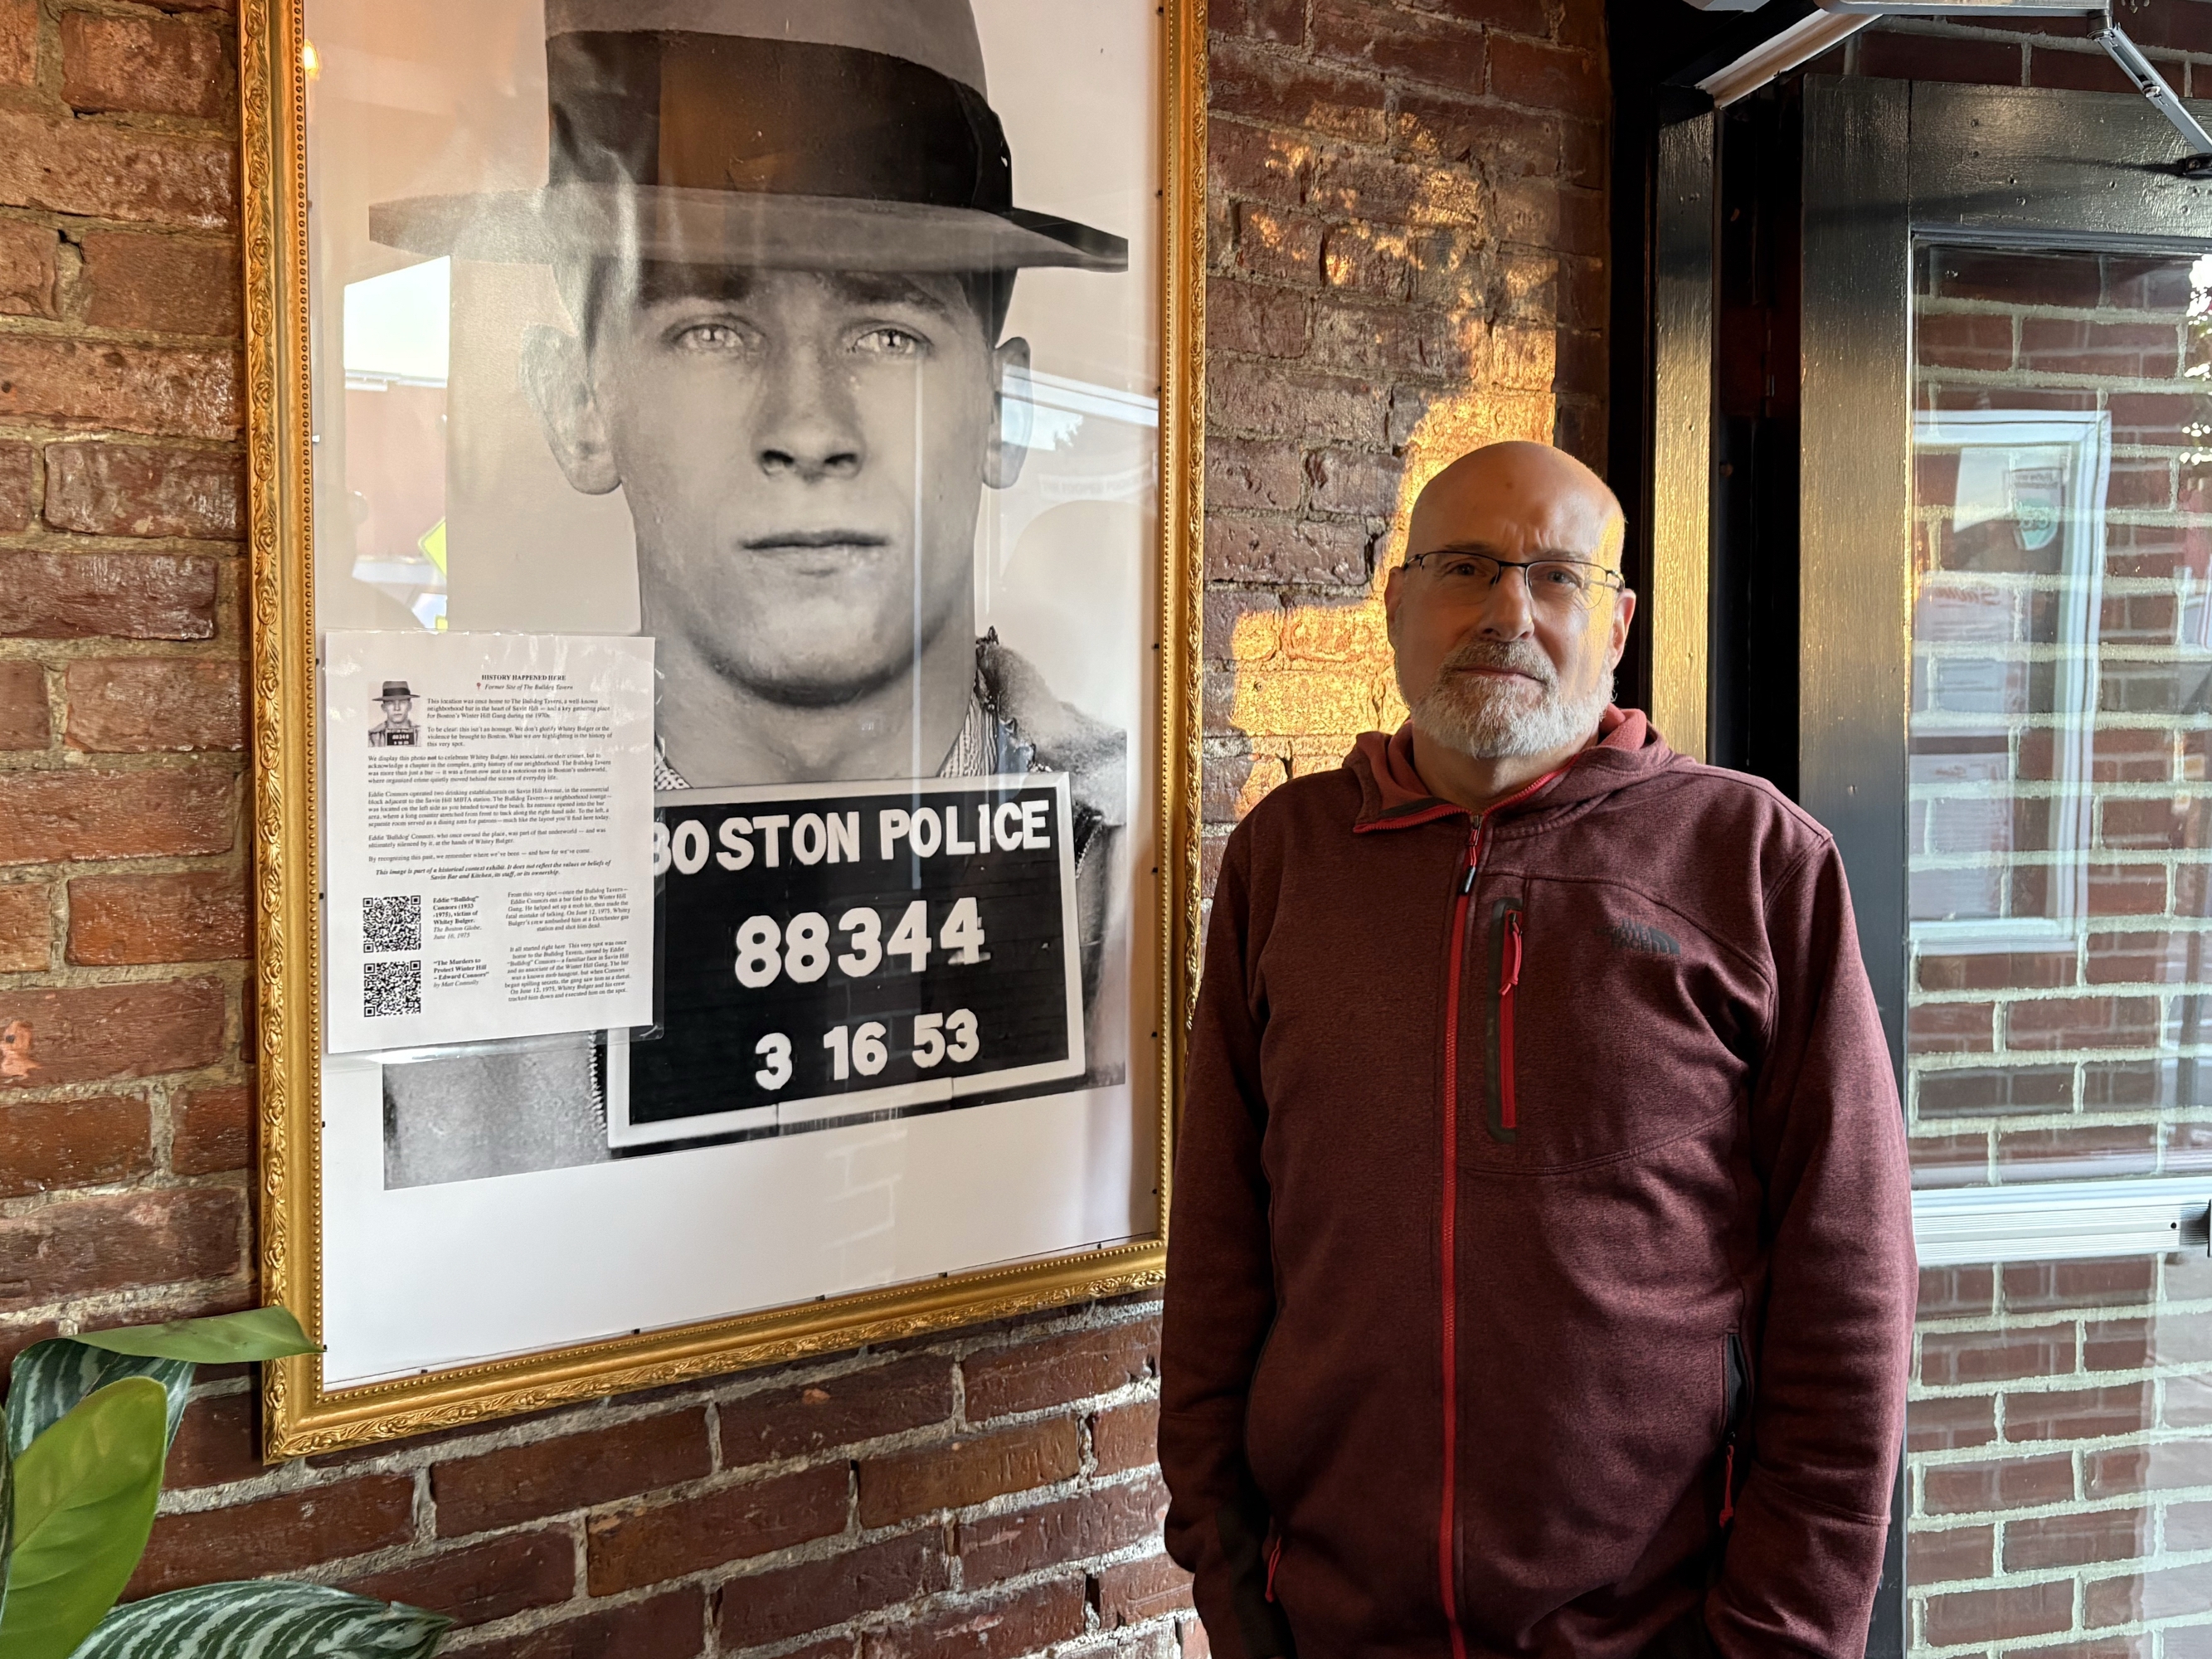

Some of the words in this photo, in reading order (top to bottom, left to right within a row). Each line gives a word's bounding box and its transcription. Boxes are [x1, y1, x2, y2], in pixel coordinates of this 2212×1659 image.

[652, 810, 861, 875] BOSTON
[879, 799, 1051, 860] POLICE
[734, 896, 992, 989] 88344
[755, 1032, 794, 1091] 3
[823, 1020, 889, 1081] 16
[912, 1007, 980, 1069] 53
